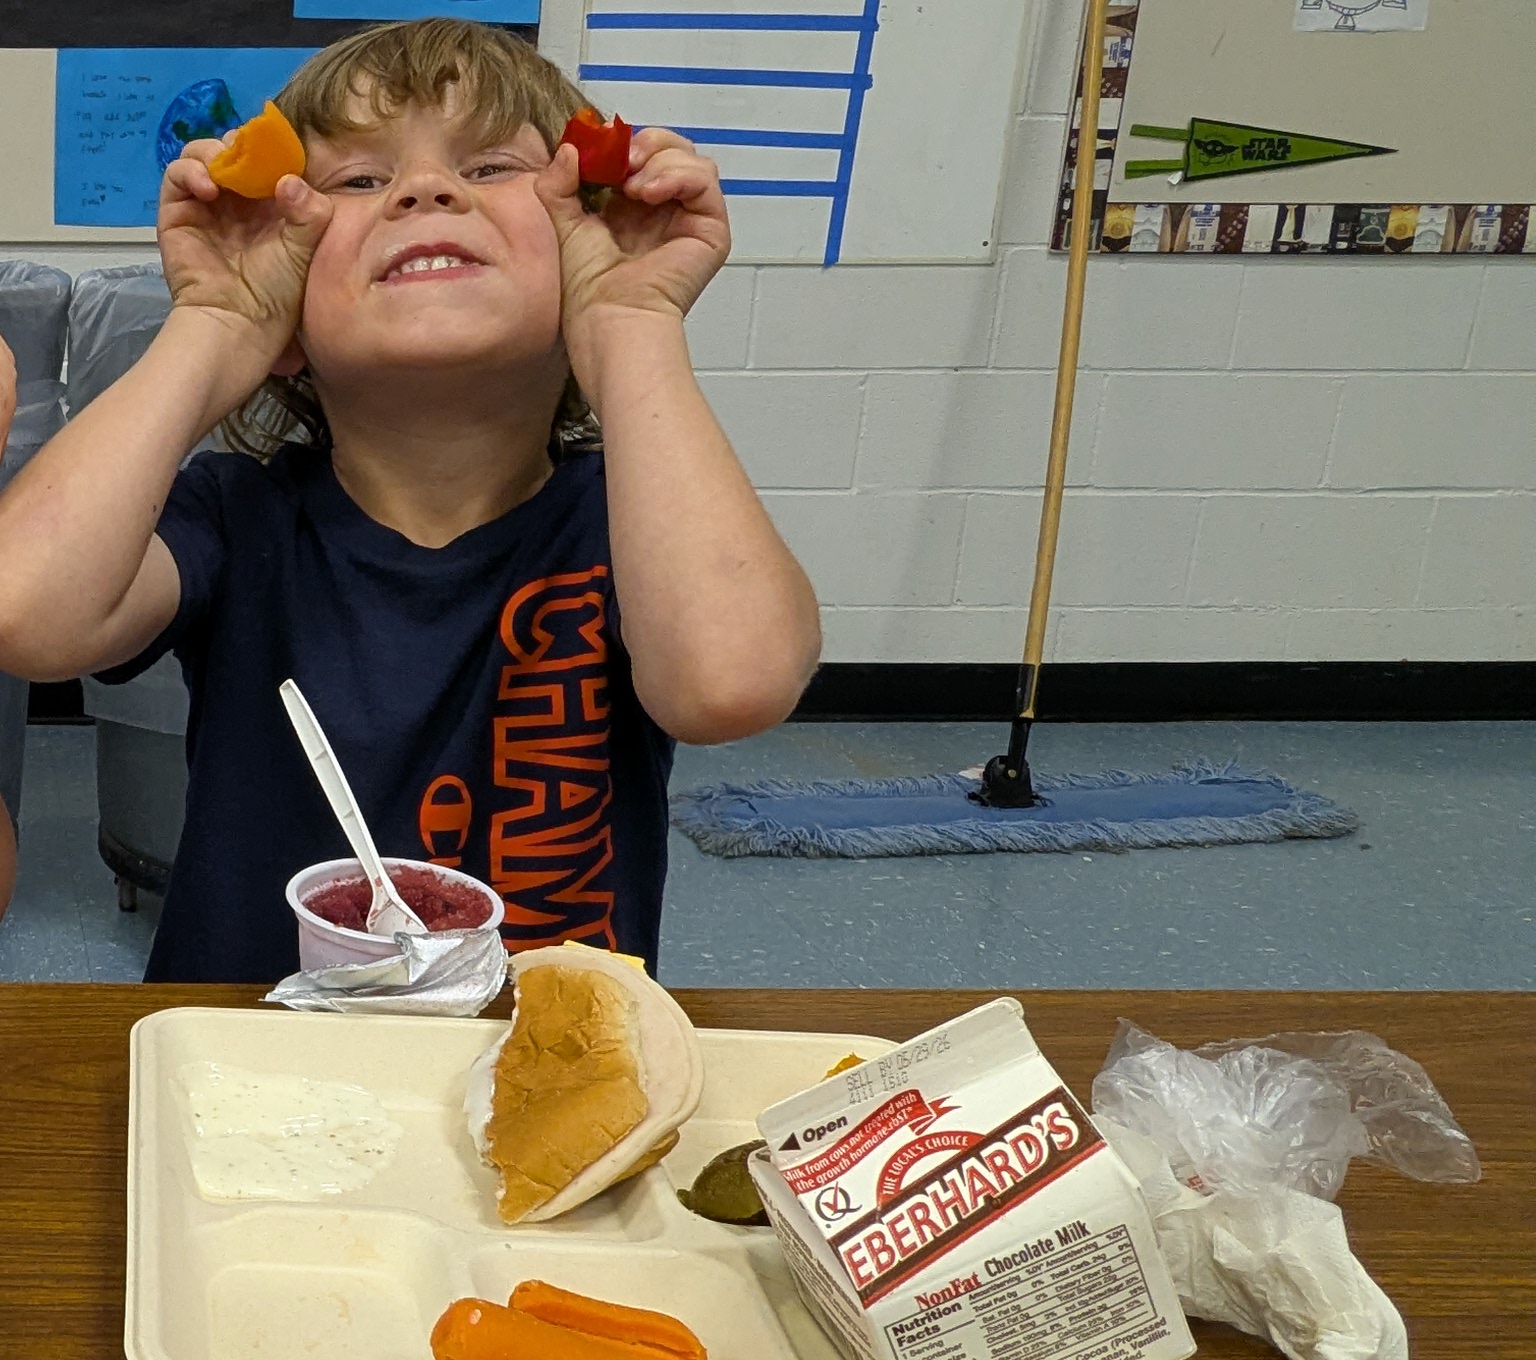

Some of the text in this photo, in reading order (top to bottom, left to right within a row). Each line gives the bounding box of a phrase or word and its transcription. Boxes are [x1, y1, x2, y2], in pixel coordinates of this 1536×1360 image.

[1241, 145, 1292, 161] WARS
[1248, 138, 1292, 150] STAR
[845, 1068, 873, 1092] SELL
[802, 1115, 848, 1144] Open
[805, 1155, 830, 1175] from
[895, 1092, 918, 1110] with
[796, 1179, 816, 1192] the
[816, 1158, 852, 1183] growth
[882, 1135, 969, 1195] THE LOCAL'S CHOICE
[840, 1102, 1079, 1290] EBERHARD'S
[914, 1220, 1091, 1312] NonFat Chocolate Milk
[891, 1302, 962, 1337] Nutrition
[897, 1324, 941, 1347] Facts
[1111, 1317, 1167, 1349] (Processed
